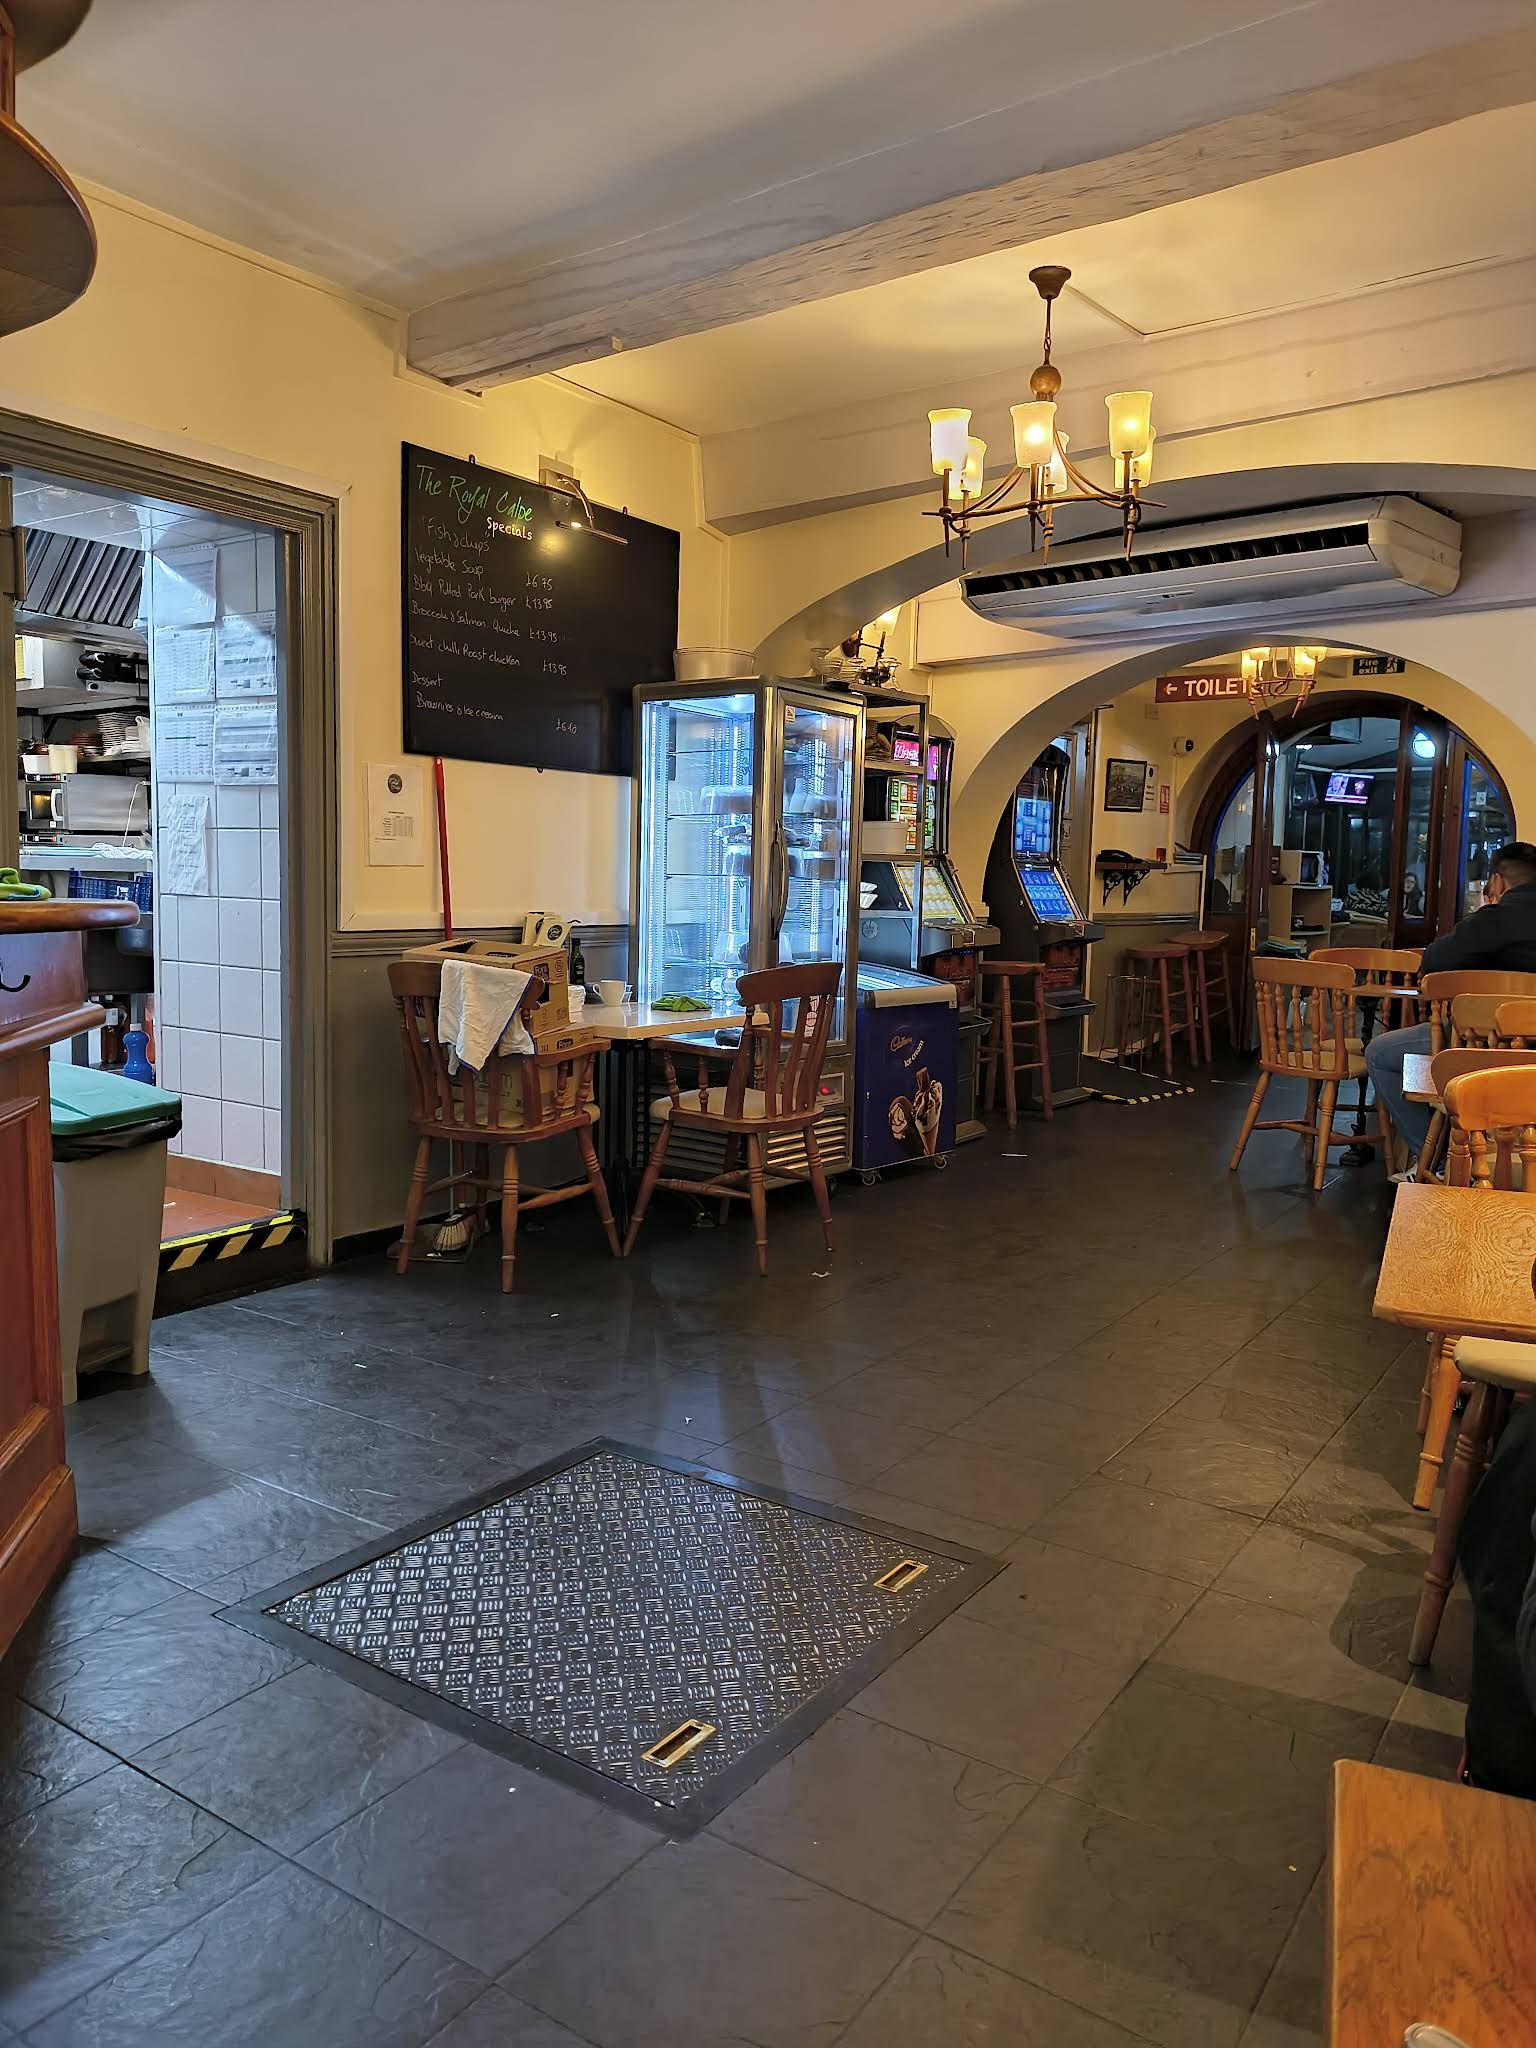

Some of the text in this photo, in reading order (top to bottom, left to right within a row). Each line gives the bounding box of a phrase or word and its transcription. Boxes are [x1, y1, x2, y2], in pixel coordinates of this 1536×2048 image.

[417, 464, 532, 524] The Royal Calpe
[486, 516, 533, 540] Specials
[414, 547, 456, 574] Vegetable
[462, 559, 484, 581] Soup
[489, 587, 516, 612] burger
[456, 610, 486, 627] Salmon
[462, 643, 487, 661] Roast
[1358, 659, 1379, 667] Fire
[1358, 666, 1378, 675] exit
[411, 670, 443, 687] Dessert
